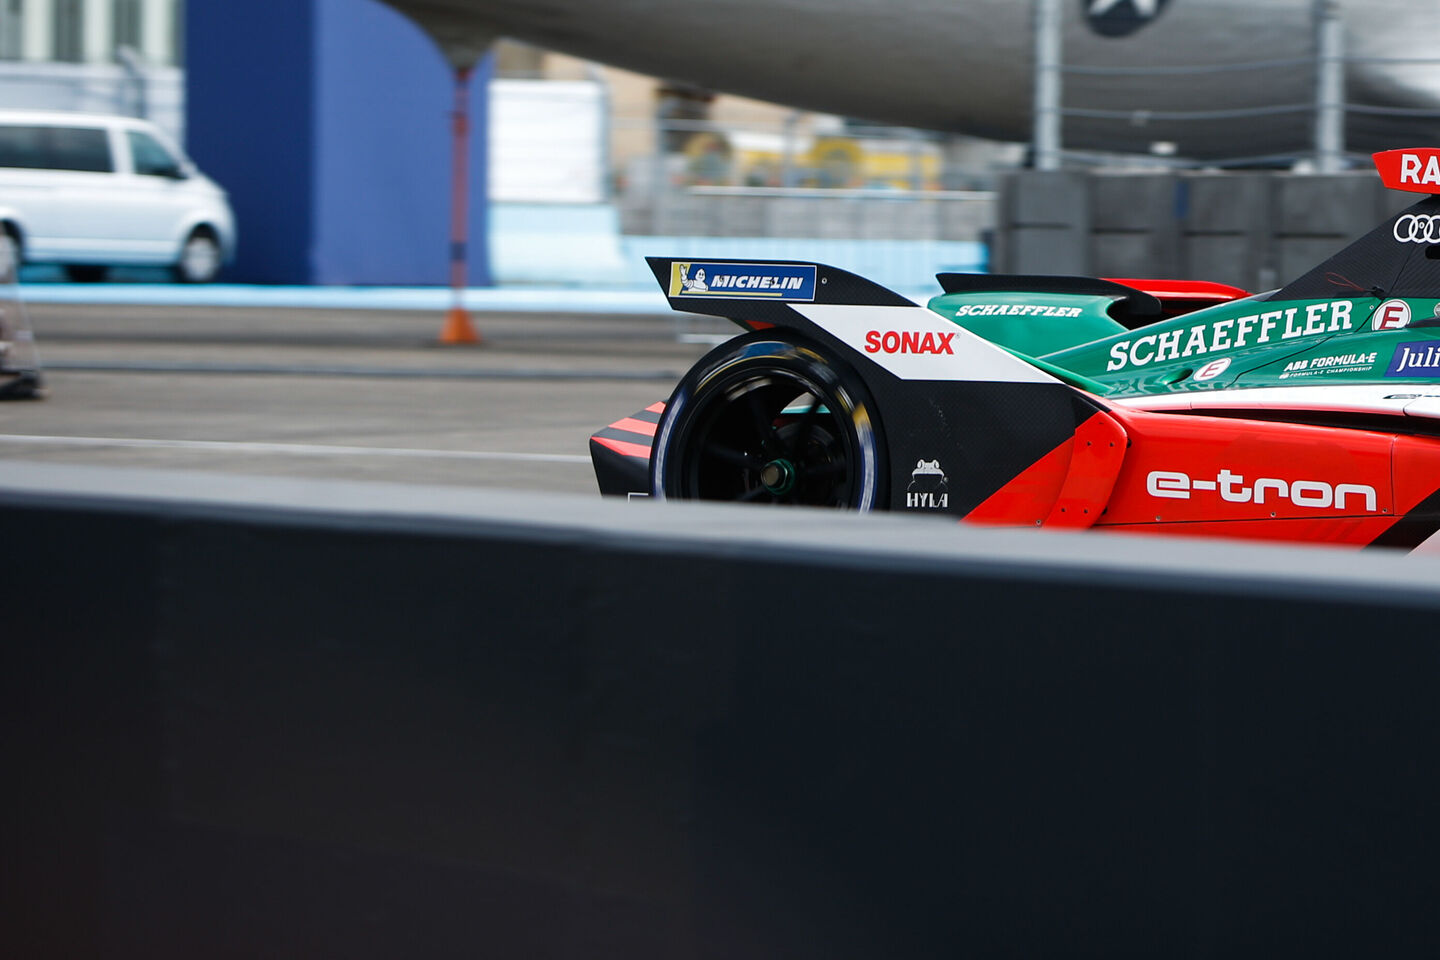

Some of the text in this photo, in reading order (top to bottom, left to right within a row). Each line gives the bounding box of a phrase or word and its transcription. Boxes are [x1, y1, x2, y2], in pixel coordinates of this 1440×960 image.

[710, 274, 804, 290] MICHELIN
[955, 304, 1083, 318] SCHAEFFLER
[864, 330, 956, 355] SONAX
[1106, 300, 1354, 372] SCHAEFFLER
[1283, 359, 1309, 372] ABB
[1146, 469, 1377, 512] e-tron
[906, 492, 948, 508] HYLA
